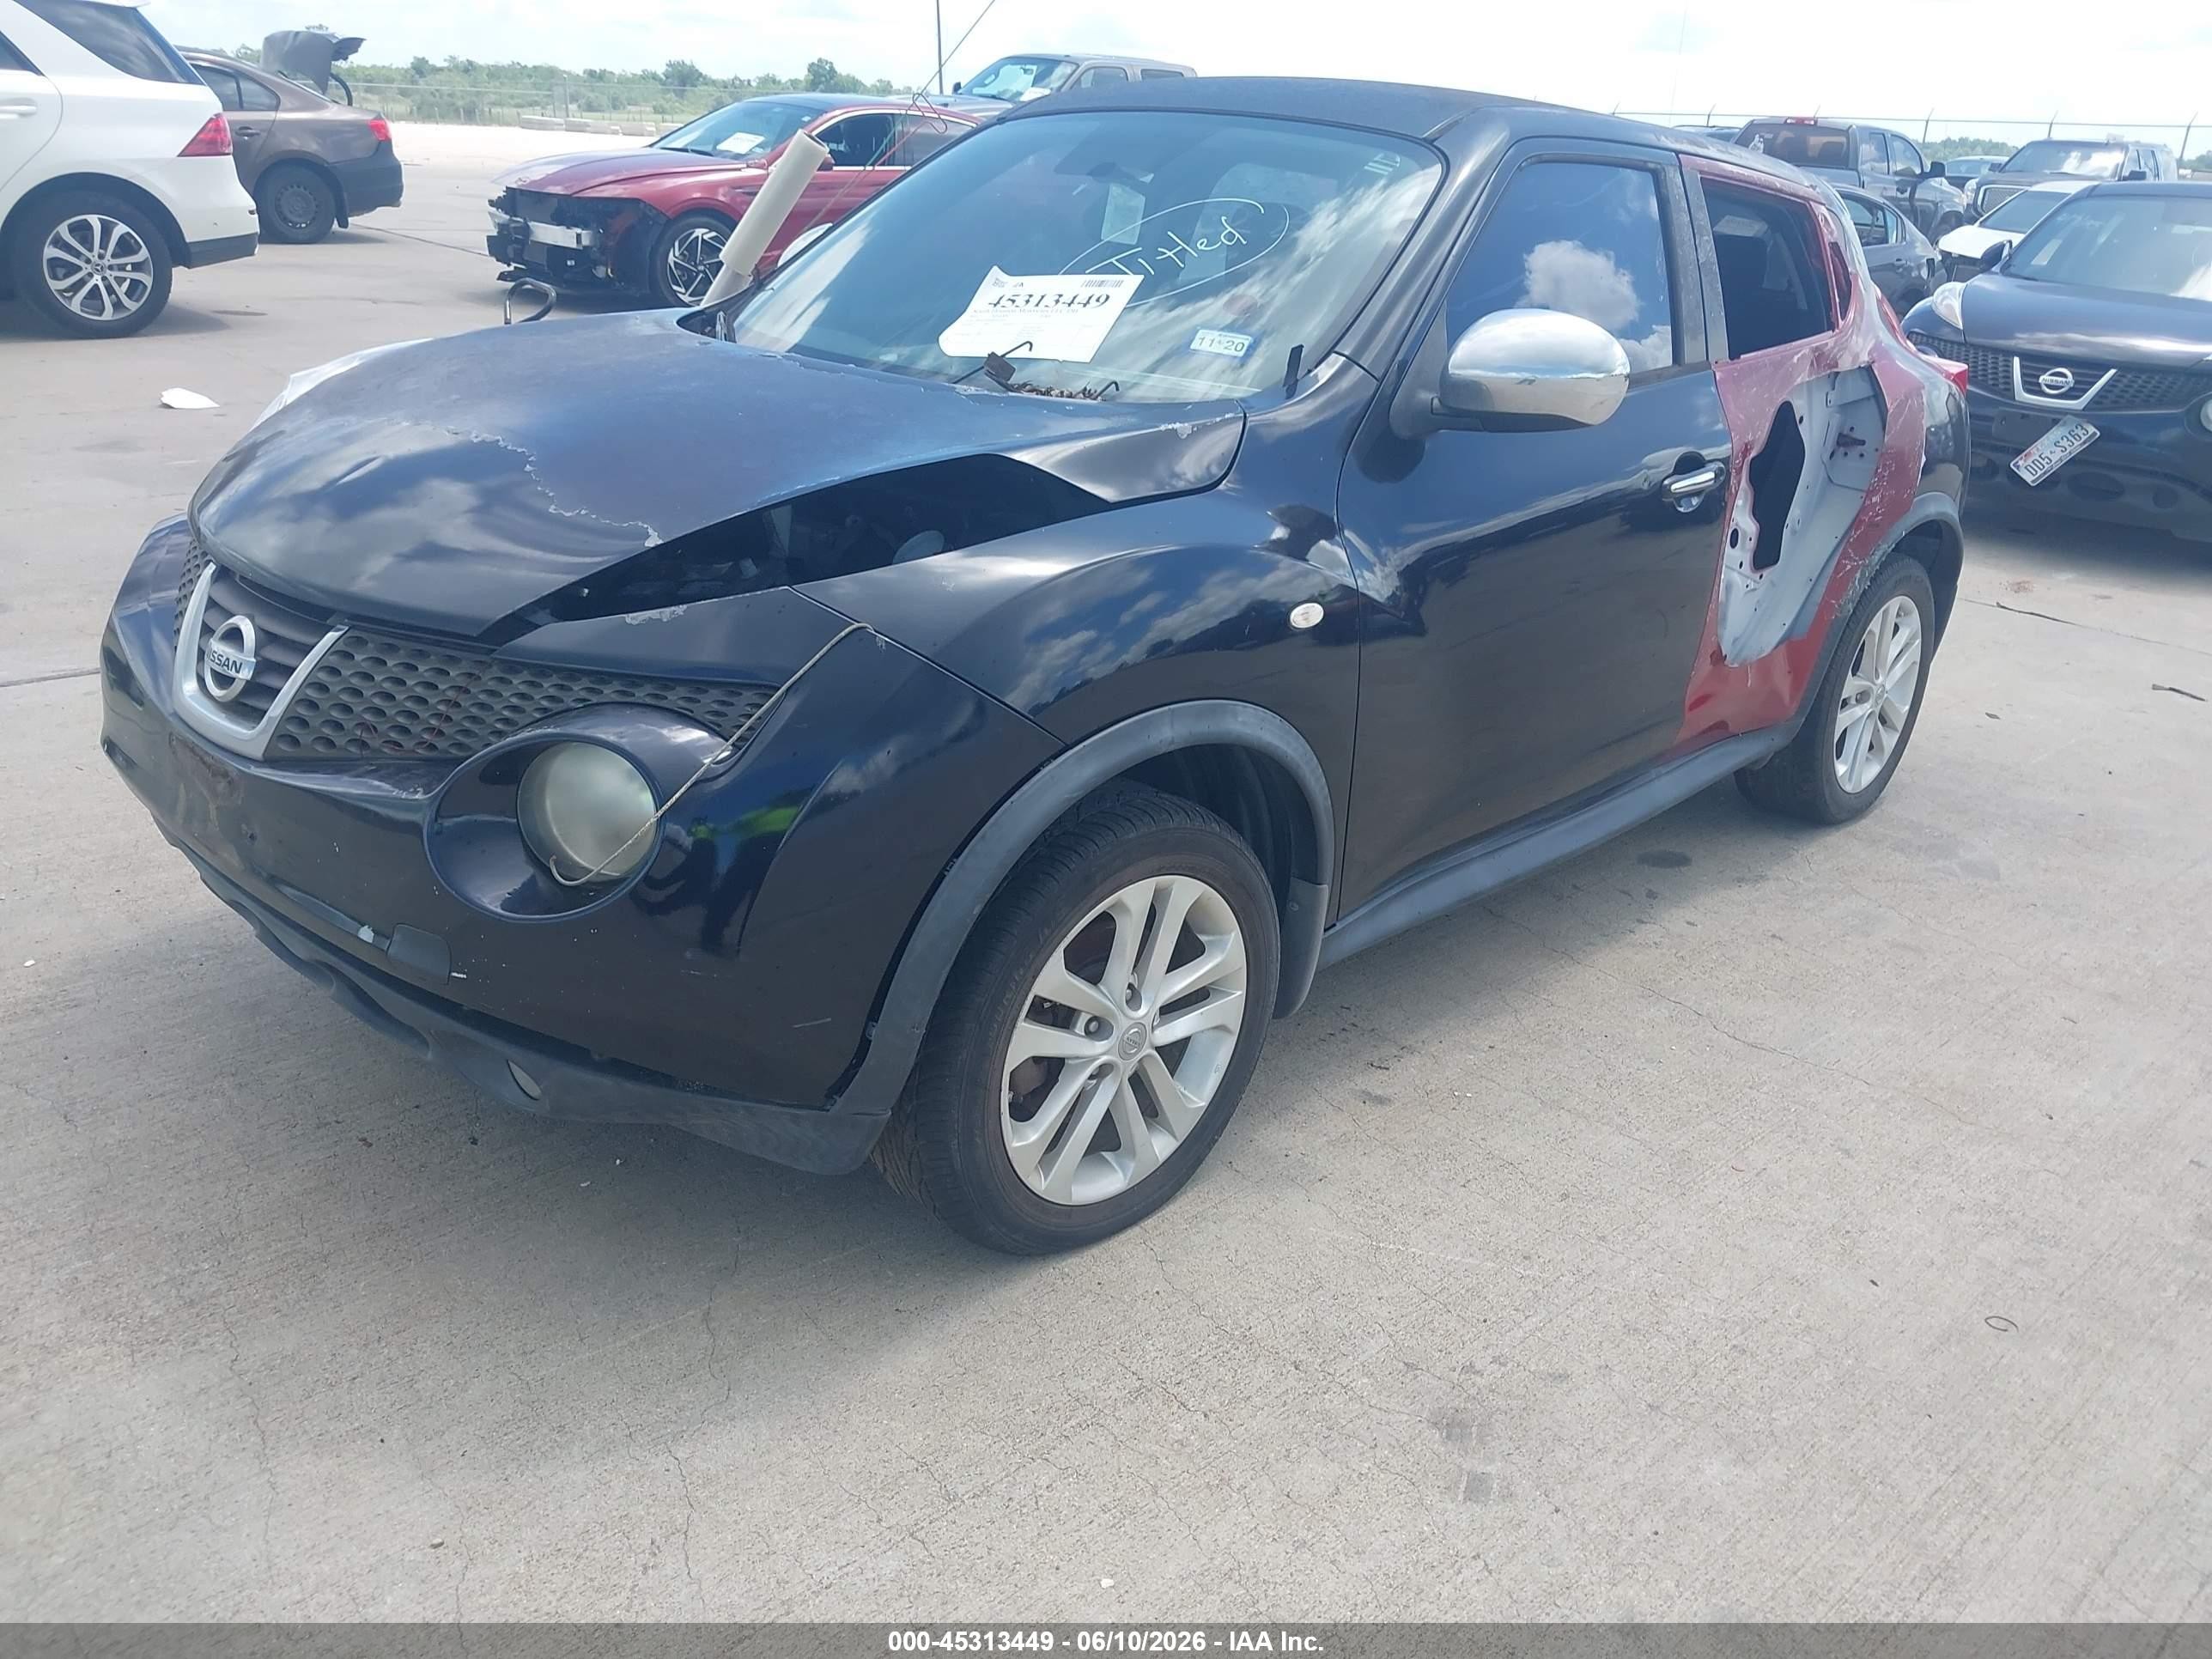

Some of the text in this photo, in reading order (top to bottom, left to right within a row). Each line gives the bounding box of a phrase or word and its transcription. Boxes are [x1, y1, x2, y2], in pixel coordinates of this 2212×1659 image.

[1085, 216, 1248, 276] Titled
[988, 293, 1111, 309] 45313449
[1223, 339, 1245, 352] 20
[2042, 377, 2070, 386] NISSAN
